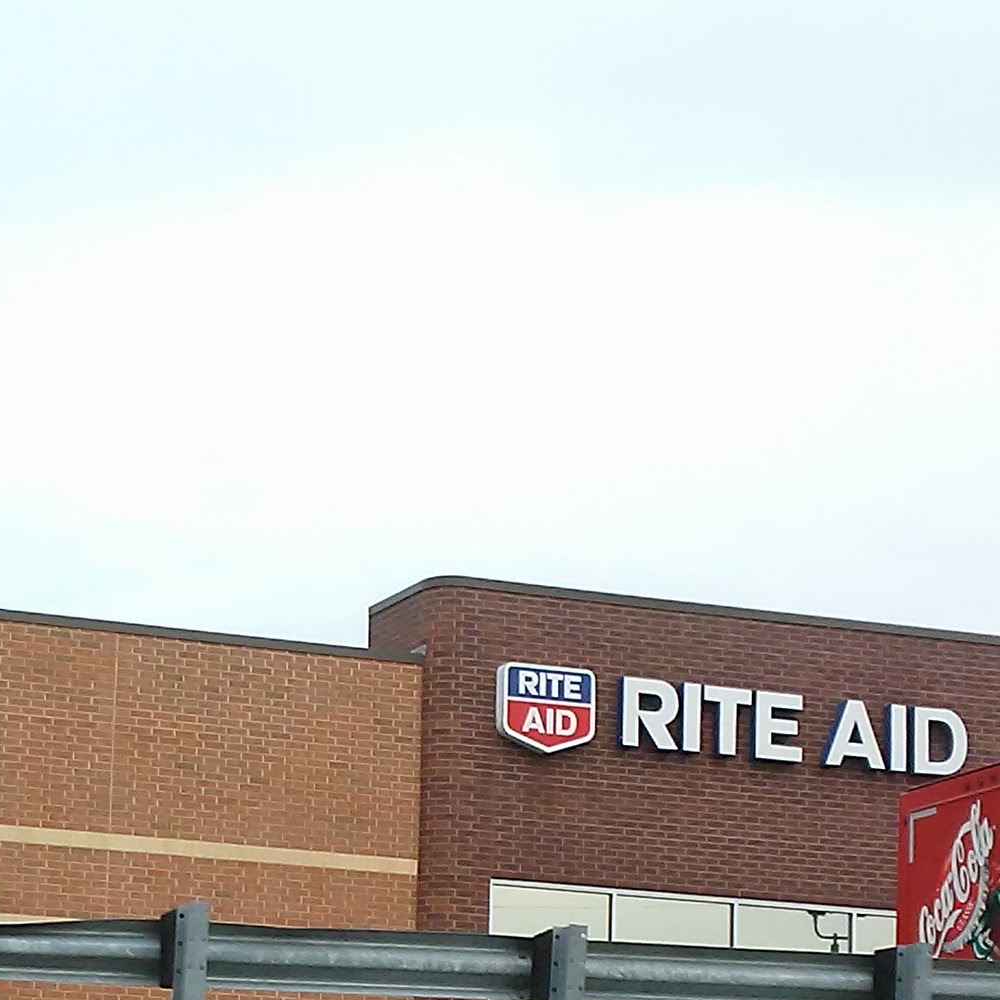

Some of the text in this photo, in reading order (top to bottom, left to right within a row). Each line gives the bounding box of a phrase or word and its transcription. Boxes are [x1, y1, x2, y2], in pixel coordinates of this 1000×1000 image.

[518, 669, 582, 700] RITE
[521, 706, 578, 736] AID
[620, 676, 968, 776] RITE AID
